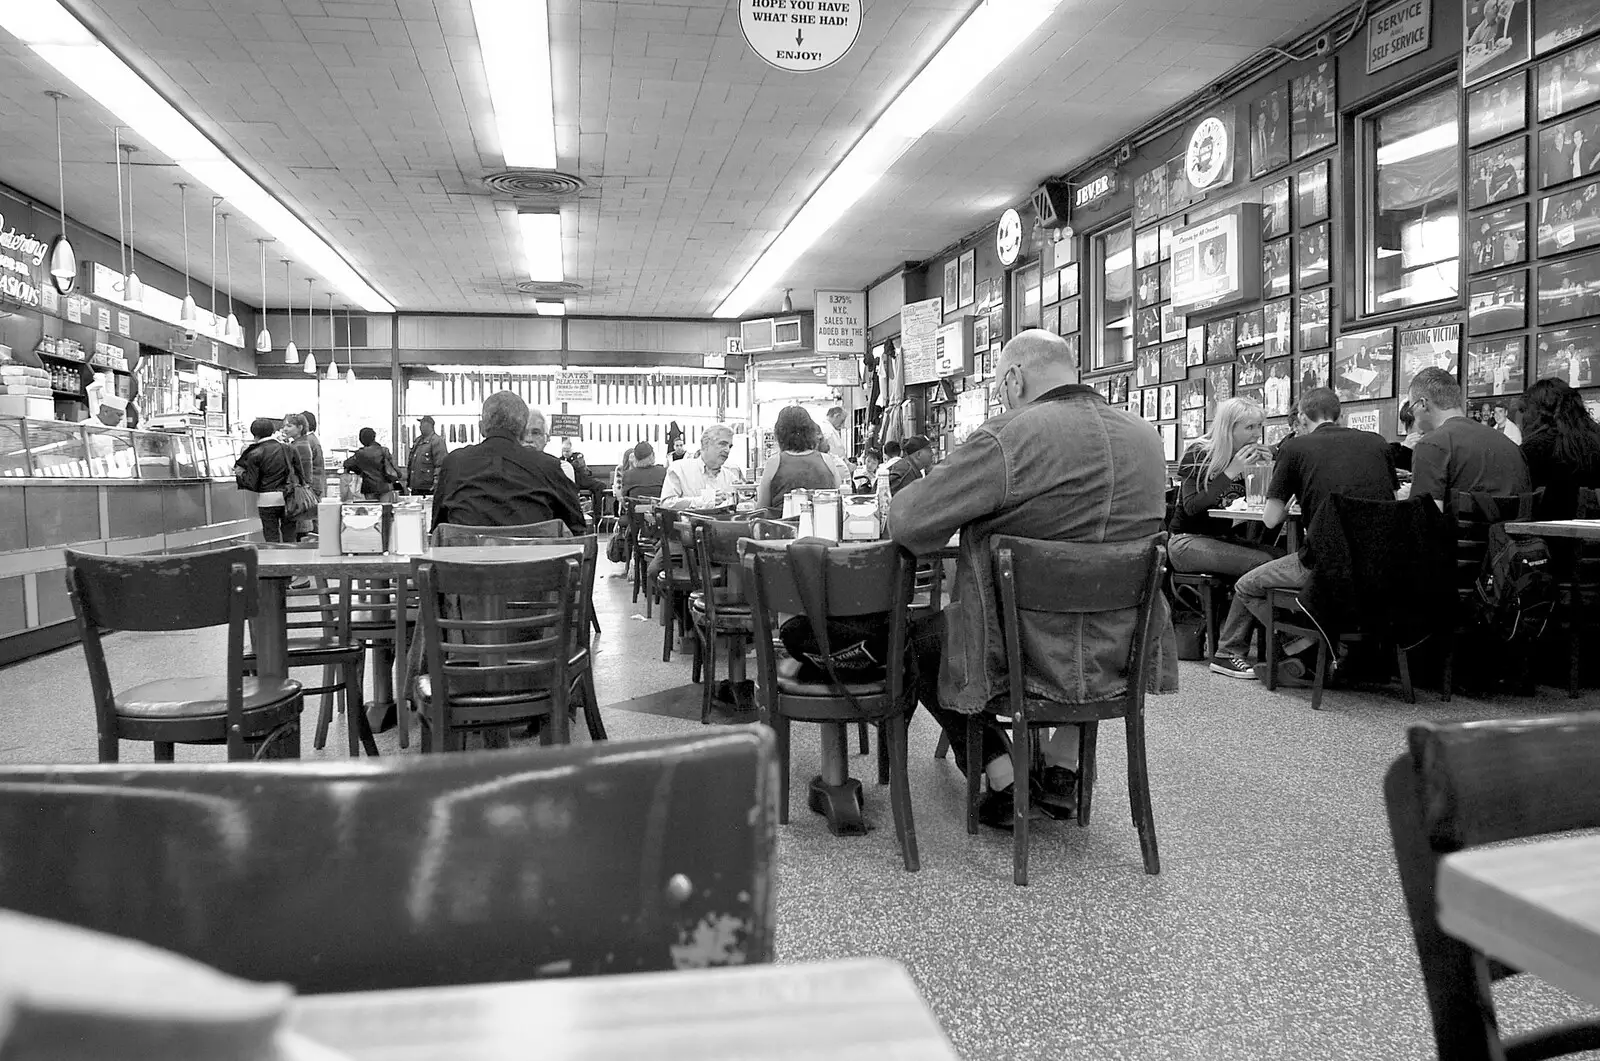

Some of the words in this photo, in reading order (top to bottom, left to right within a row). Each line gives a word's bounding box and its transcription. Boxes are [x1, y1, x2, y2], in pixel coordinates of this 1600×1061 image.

[752, 0, 786, 9] HOPE
[790, 0, 814, 10] YOU
[818, 1, 850, 12] HAVE
[753, 12, 788, 23] WHAT
[791, 14, 816, 25] SHE
[819, 16, 848, 26] HAD!
[1377, 2, 1422, 35] SERVICE
[1372, 42, 1390, 62] SELF
[1391, 26, 1425, 53] SERVICE
[776, 50, 822, 61] ENJOY!
[1075, 175, 1109, 206] JEVER
[823, 316, 844, 325] SALES
[846, 317, 858, 326] TAX
[818, 327, 839, 336] ADDED
[840, 328, 849, 336] BY
[851, 328, 863, 337] THE
[1400, 330, 1431, 347] CHOKING
[1432, 325, 1458, 343] VICTIM
[729, 339, 743, 353] EX
[827, 338, 854, 347] CASHIER
[1351, 414, 1376, 423] WAITER
